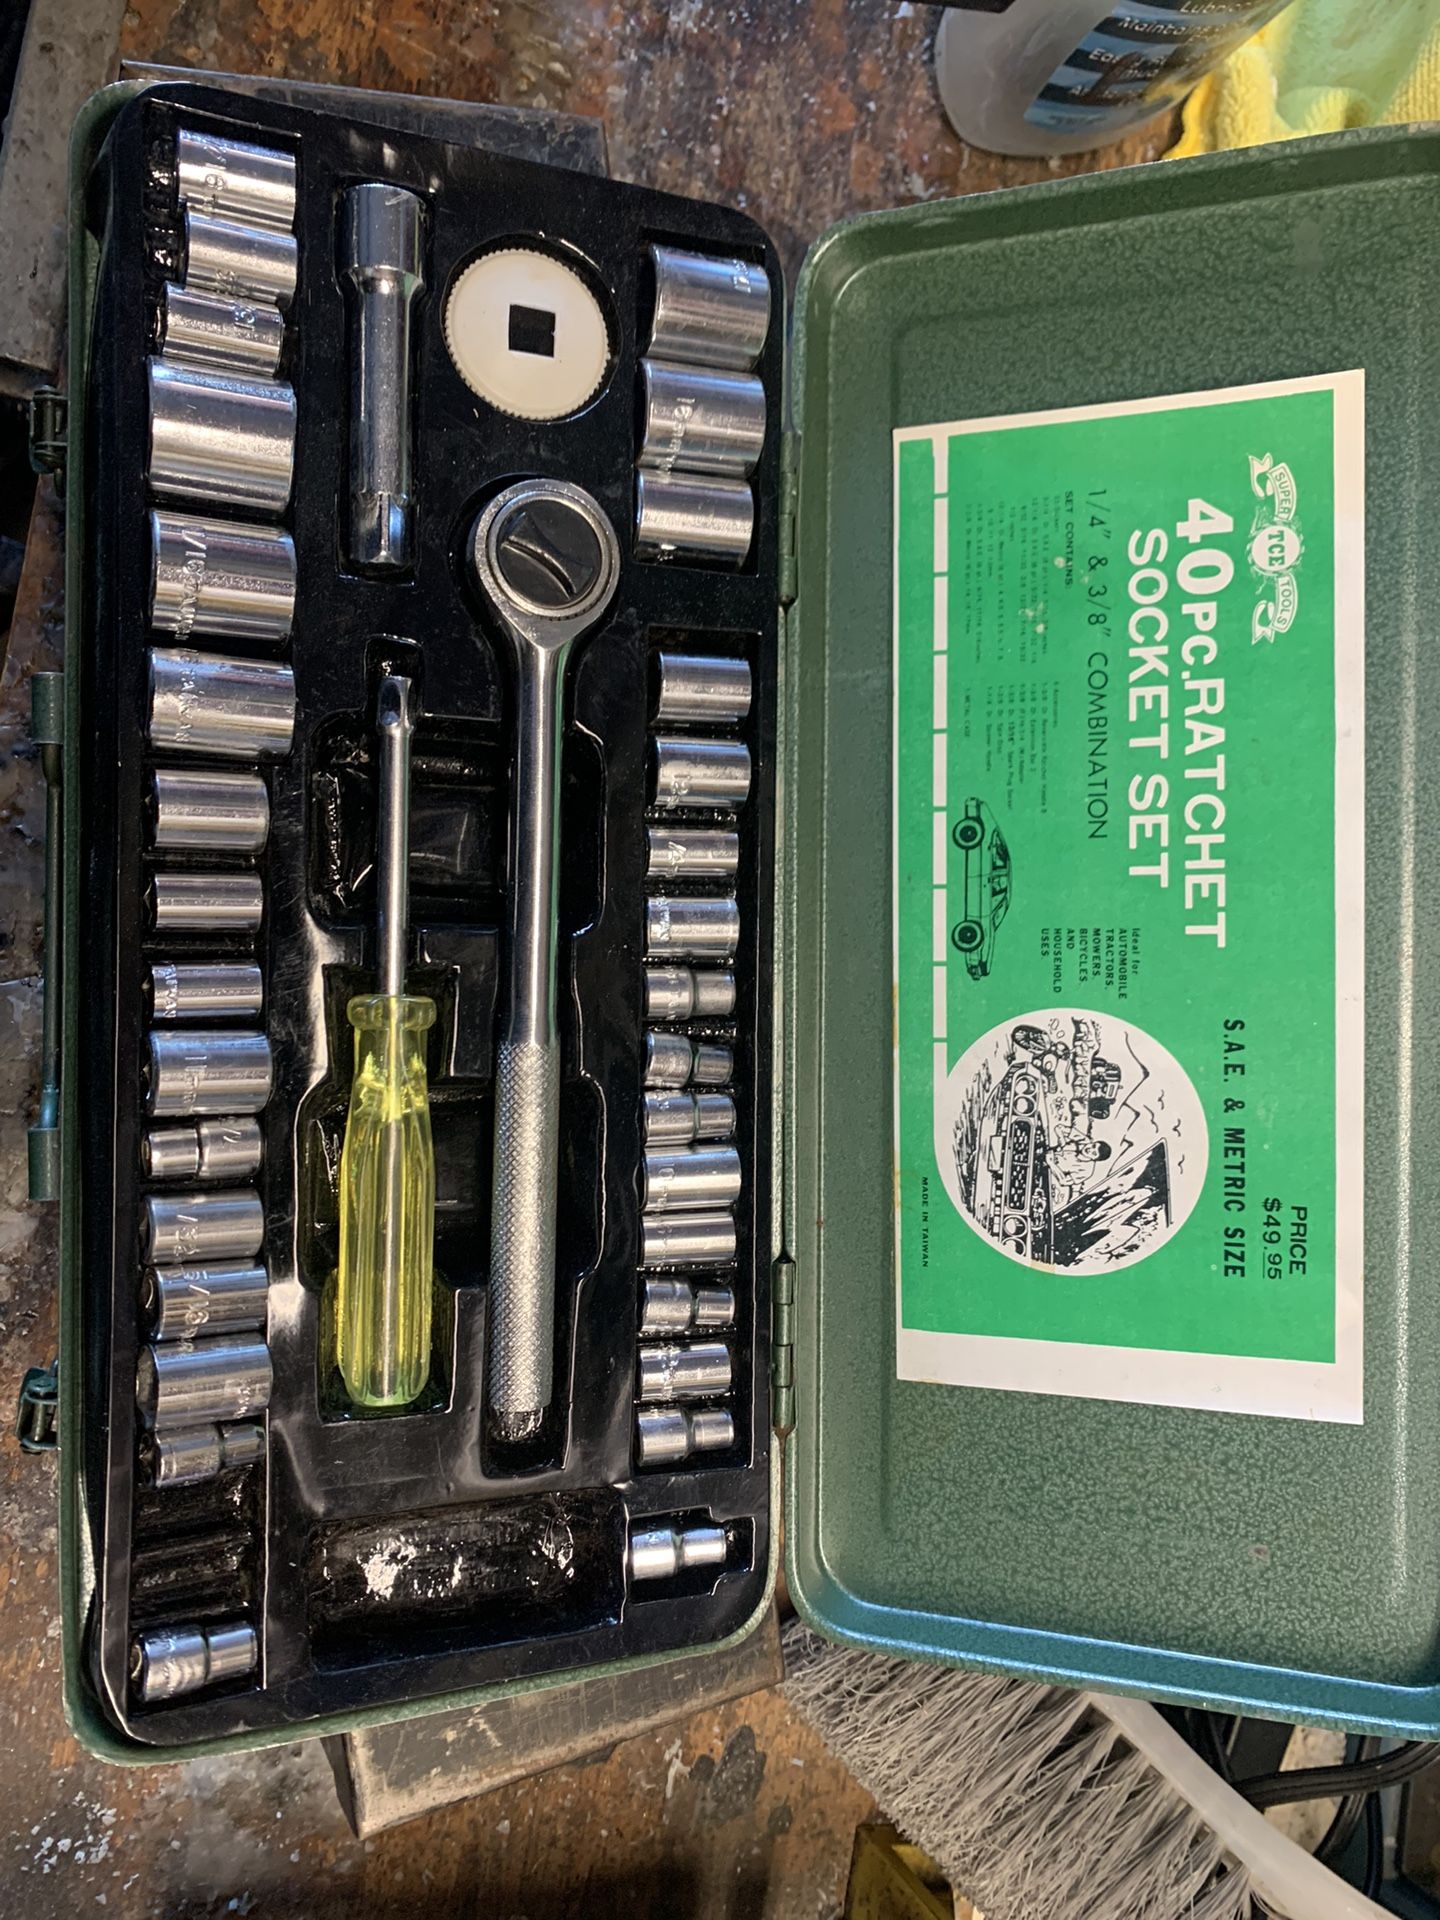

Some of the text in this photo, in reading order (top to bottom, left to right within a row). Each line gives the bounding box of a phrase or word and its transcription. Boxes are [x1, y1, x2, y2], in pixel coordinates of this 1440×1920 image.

[1065, 490, 1074, 514] SET
[1267, 471, 1292, 626] SUPER TCE TOOLS
[1085, 488, 1112, 839] 1/4" & 3/8" COMBINATION
[1127, 528, 1169, 889] SOCKET SET
[1053, 927, 1063, 994] HOUSEHOLD
[1065, 927, 1075, 950] AND
[1118, 927, 1128, 1000] AUTOMOBILE
[1132, 927, 1141, 976] Ideal for
[1222, 1018, 1246, 1279] S.A.E. & METRIC SIZE
[921, 1176, 929, 1268] MADE IN TAIWAN
[1260, 1196, 1284, 1280] $49.95
[1289, 1205, 1308, 1275] PRICE
